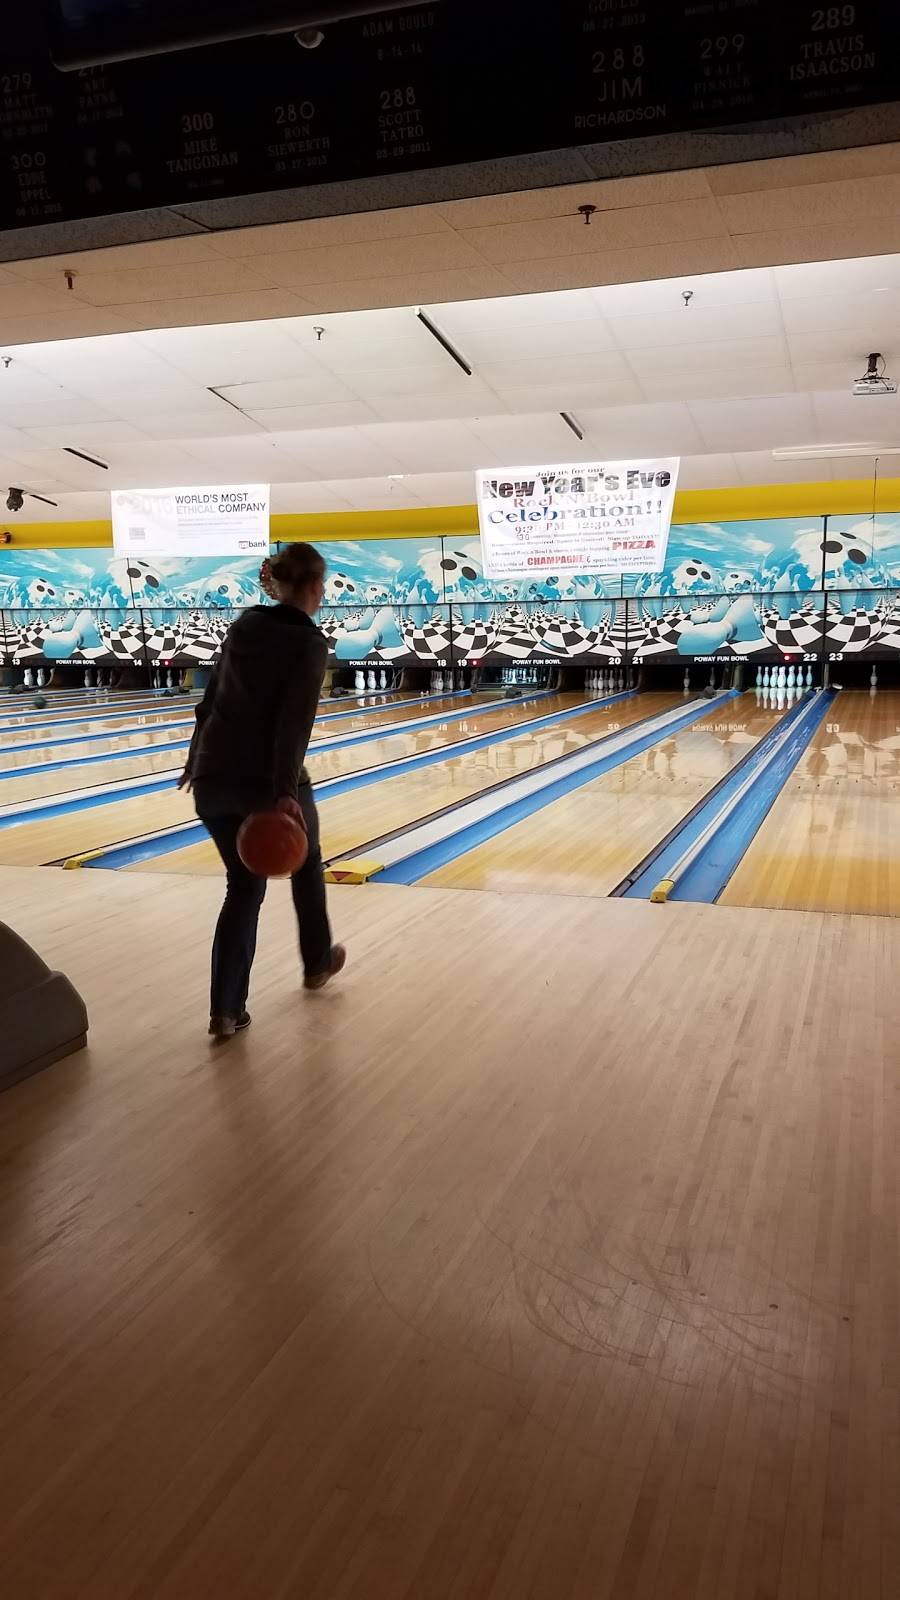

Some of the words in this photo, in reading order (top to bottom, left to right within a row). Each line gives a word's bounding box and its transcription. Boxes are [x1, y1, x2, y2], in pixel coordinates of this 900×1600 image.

[811, 4, 857, 32] 289
[699, 33, 746, 60] 299
[800, 34, 865, 60] TRAVIS
[592, 44, 646, 74] 288
[789, 51, 877, 81] ISAACSON
[1, 72, 32, 94] 279
[597, 76, 643, 103] JIM
[379, 86, 417, 111] 288
[181, 112, 215, 133] 300
[274, 100, 316, 125] 280
[377, 109, 424, 127] SCOTT
[574, 104, 669, 128] RICHARDSON
[381, 124, 425, 142] TATRO
[183, 138, 218, 155] MIKE
[9, 151, 47, 170] 300
[482, 480, 536, 499] New
[541, 472, 620, 495] Year's
[626, 470, 672, 490] Eve
[175, 494, 219, 504] WORLD'S
[220, 492, 248, 502] MOST
[176, 504, 216, 515] ETHICAL
[218, 502, 266, 513] COMPANY
[488, 500, 662, 524] Celebration!!
[614, 518, 634, 527] AM
[612, 540, 656, 550] PIZZA
[528, 554, 586, 566] CHAMPAGNE
[608, 656, 622, 665] 20
[632, 656, 644, 664] 21
[802, 654, 818, 662] 22
[828, 652, 844, 661] 23
